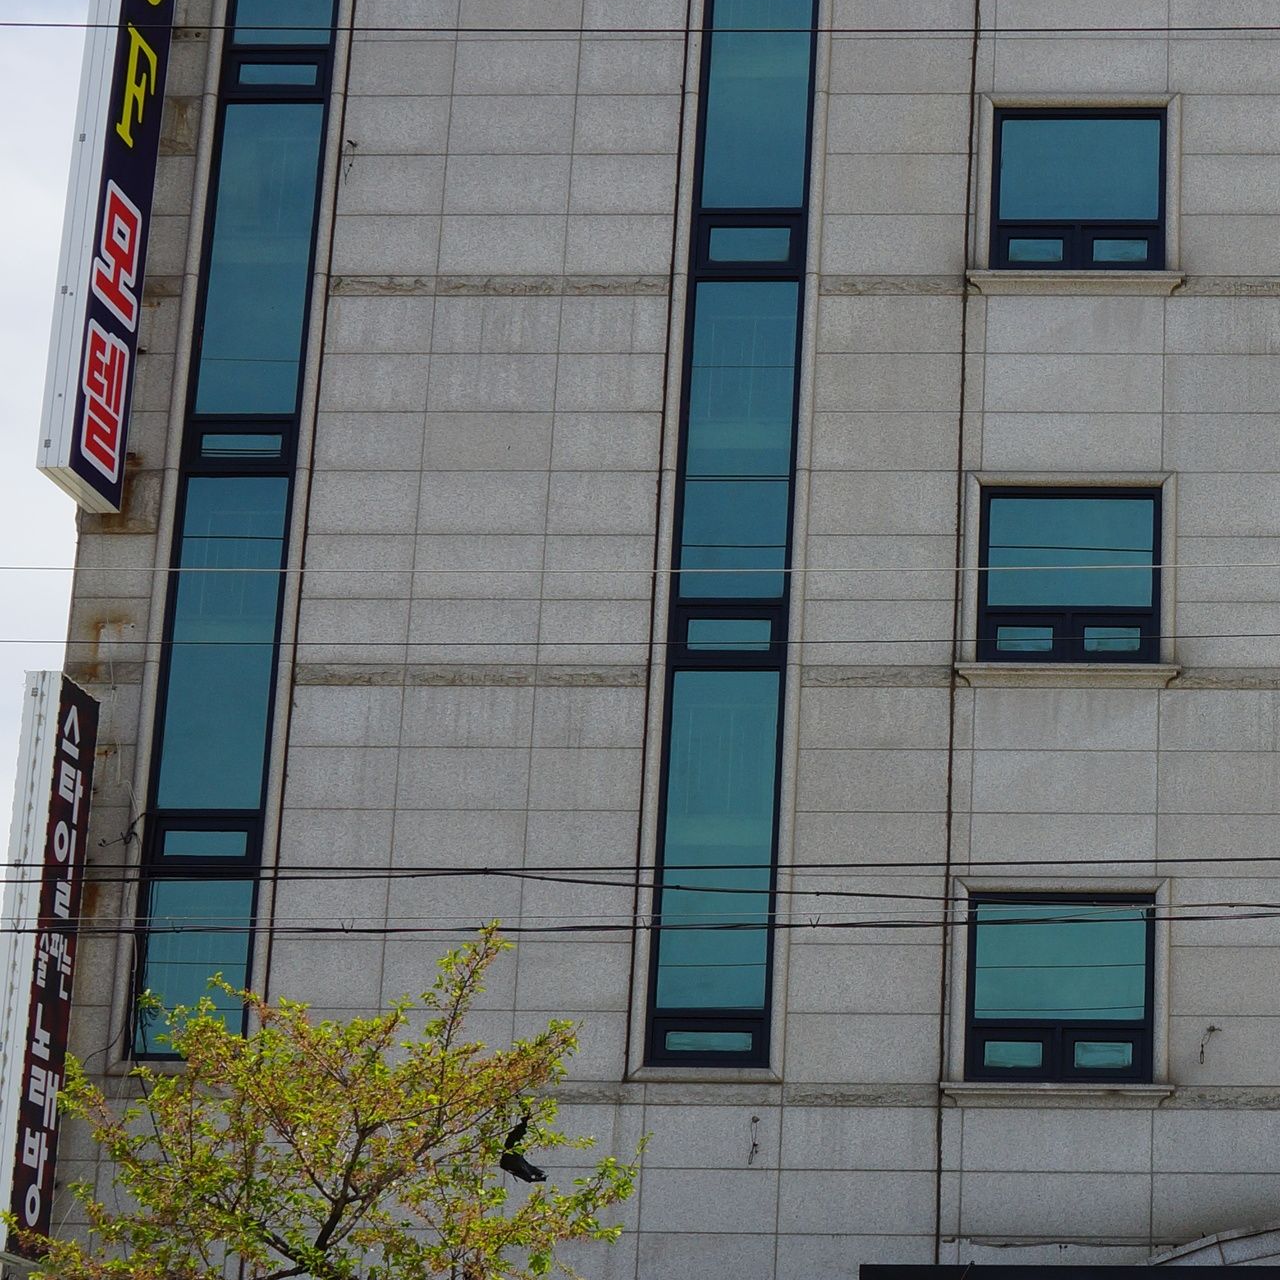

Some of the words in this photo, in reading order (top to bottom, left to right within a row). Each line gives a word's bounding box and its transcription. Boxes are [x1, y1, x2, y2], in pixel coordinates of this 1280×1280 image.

[81, 179, 143, 484] 모텔
[53, 705, 84, 921] 스타일
[23, 1003, 60, 1228] 노래방
